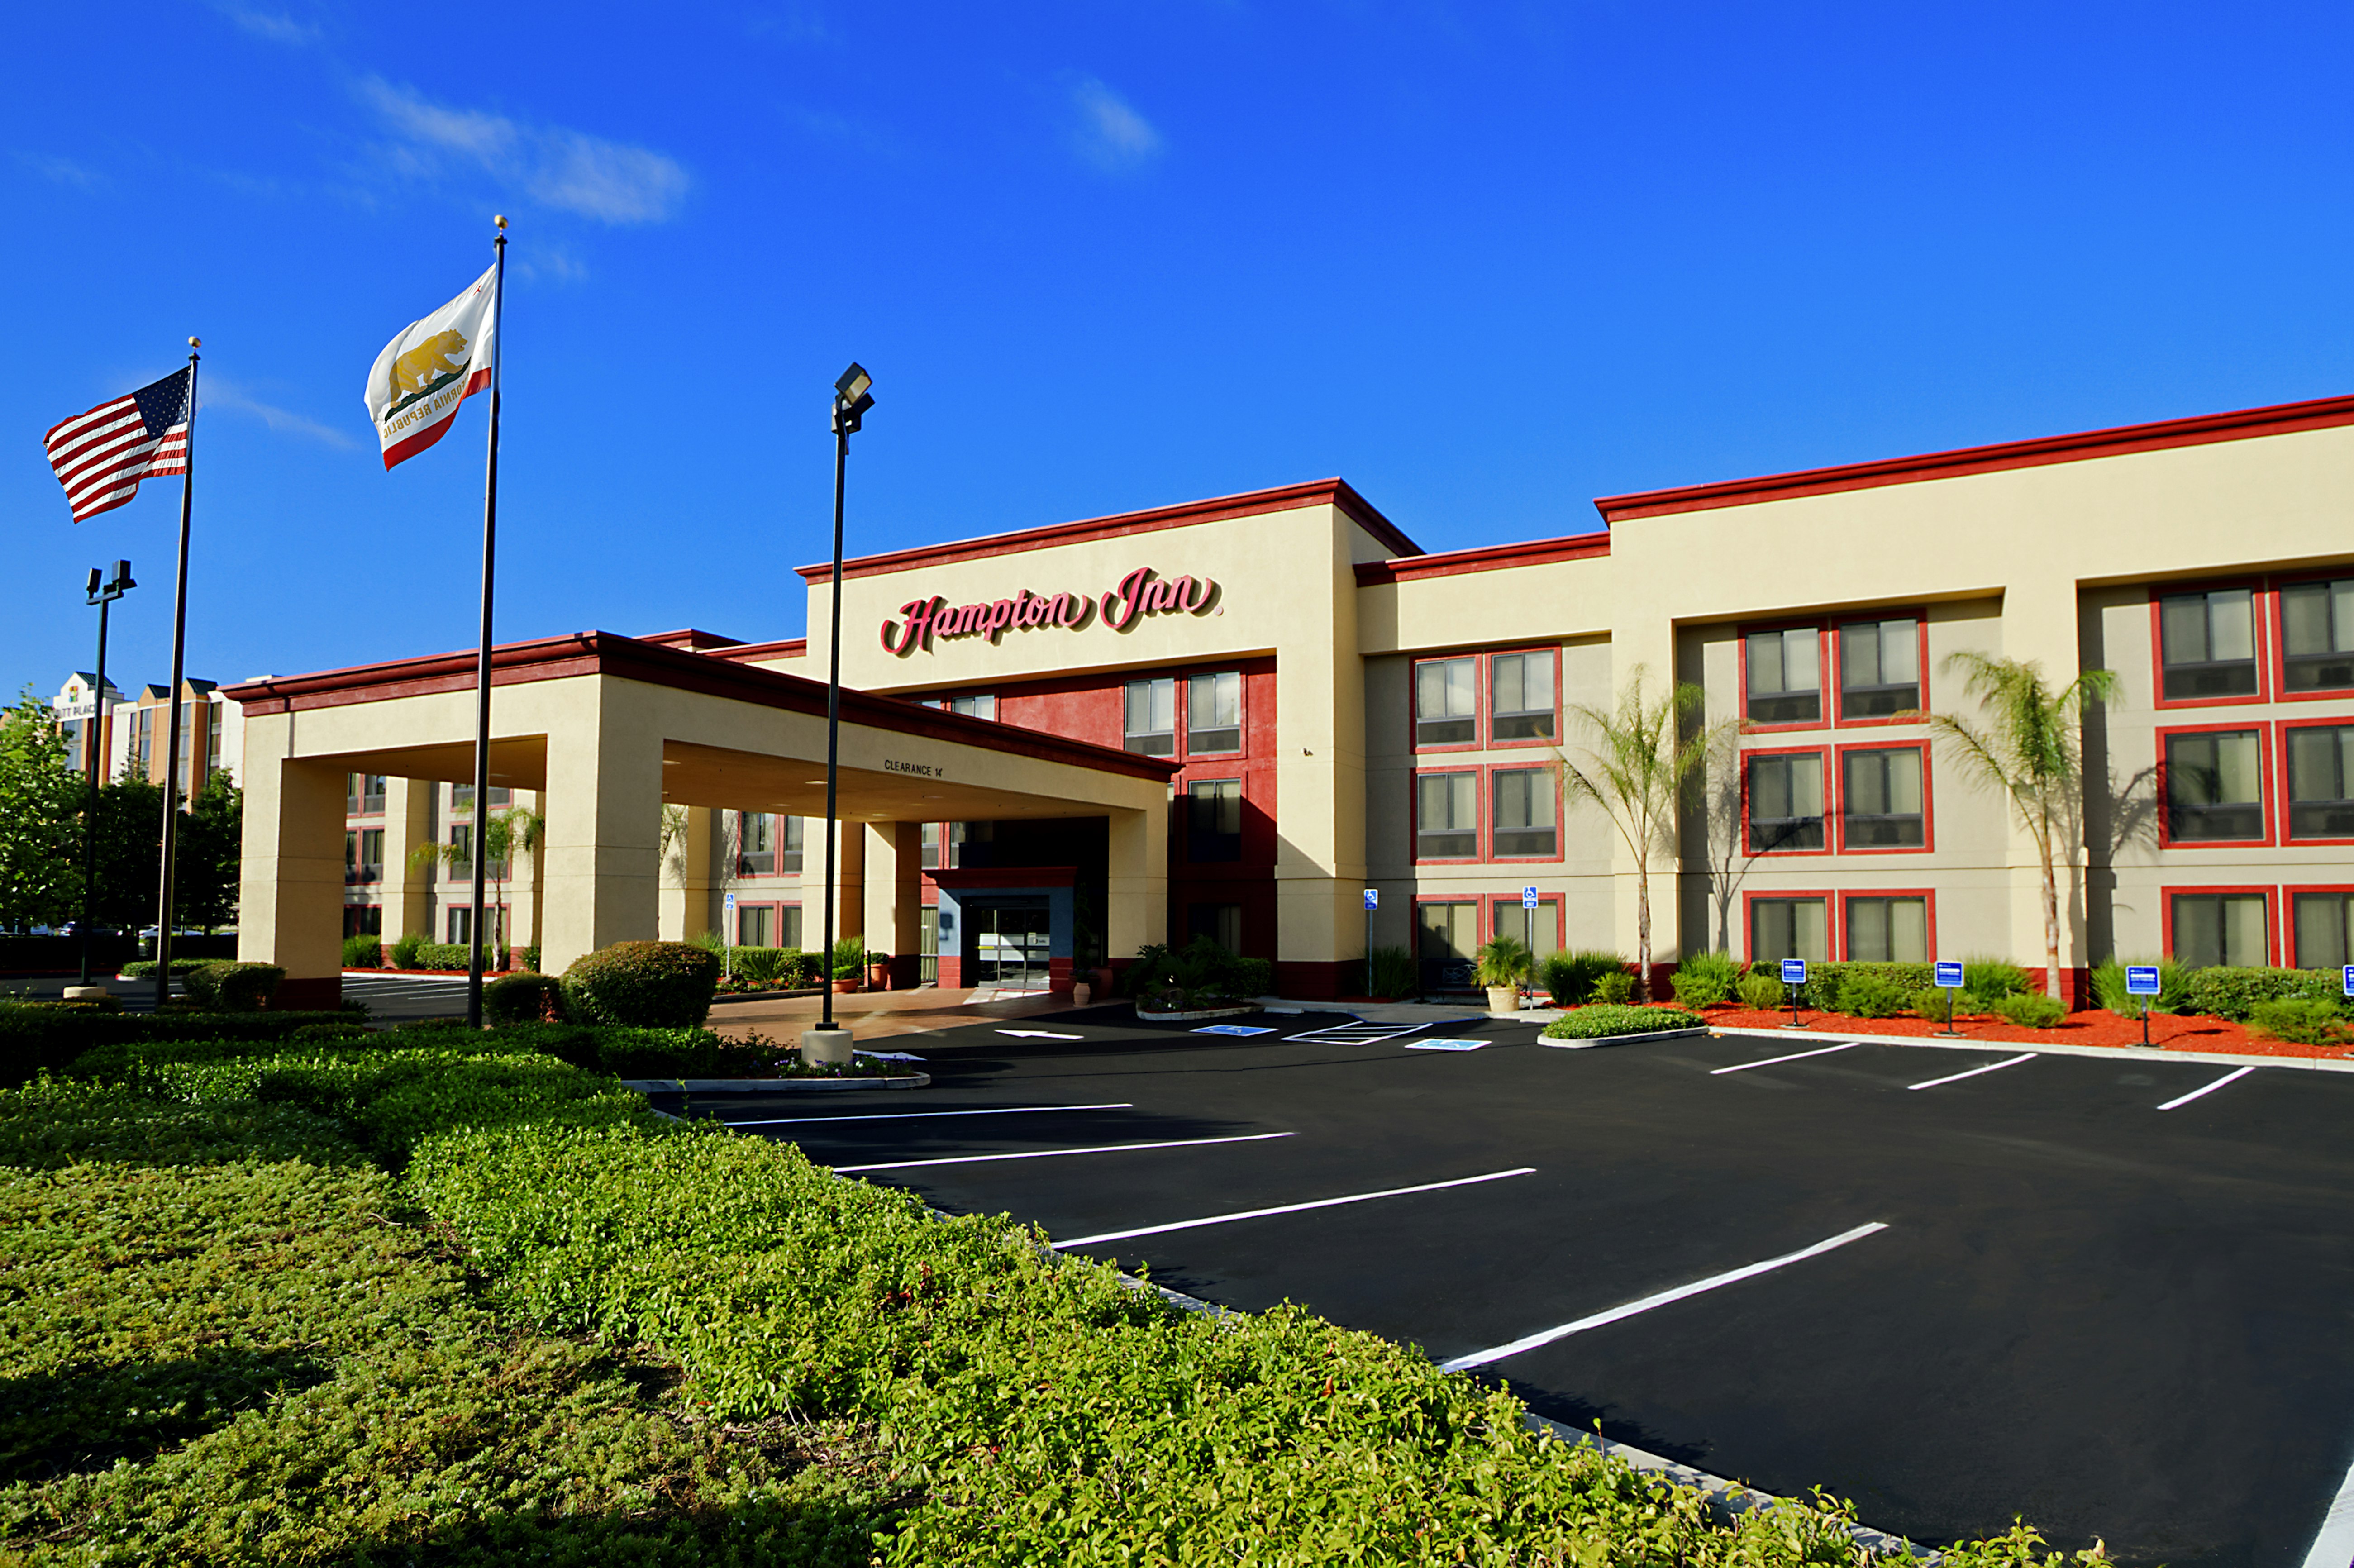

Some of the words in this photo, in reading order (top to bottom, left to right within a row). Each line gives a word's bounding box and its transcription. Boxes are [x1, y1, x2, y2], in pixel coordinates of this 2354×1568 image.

[881, 589, 1088, 653] Hampton
[1100, 567, 1212, 629] Inn
[74, 704, 95, 716] PLAC
[885, 760, 931, 775] CLEARANCE
